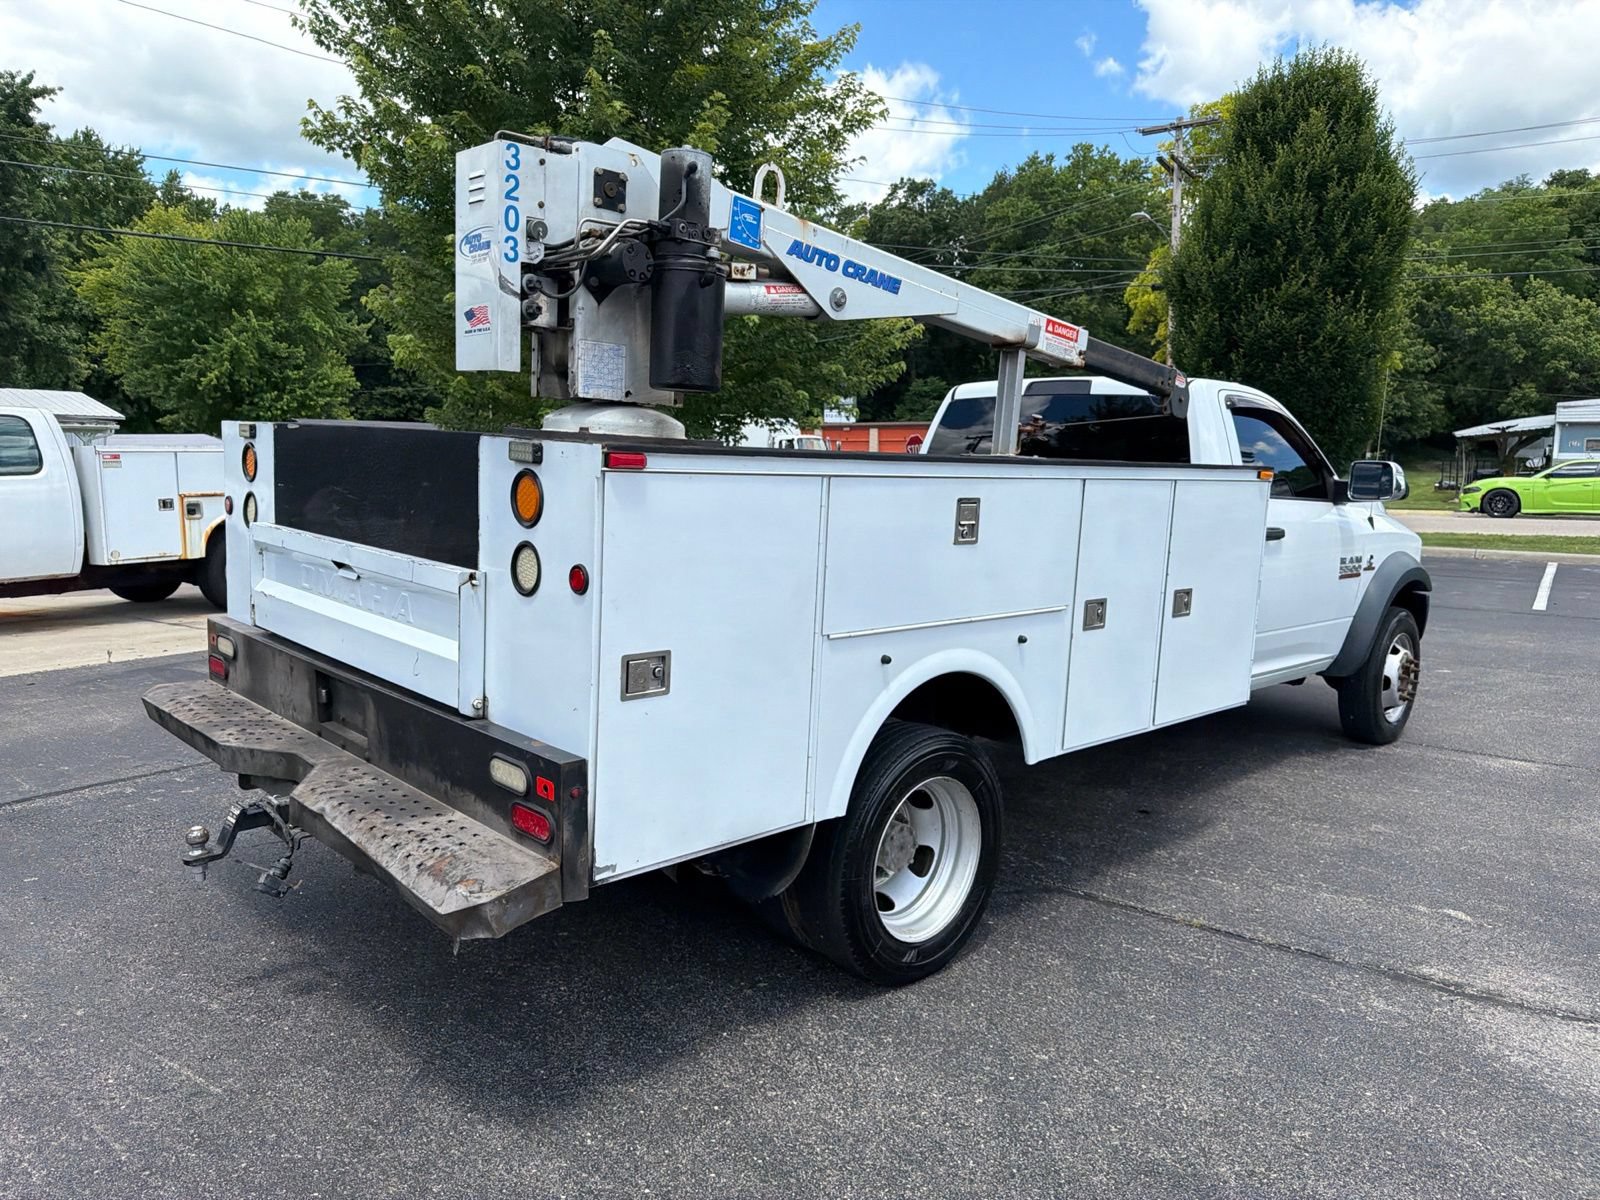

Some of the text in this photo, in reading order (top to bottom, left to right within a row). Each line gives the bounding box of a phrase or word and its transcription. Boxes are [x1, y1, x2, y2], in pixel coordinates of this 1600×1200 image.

[504, 142, 520, 263] 3203
[786, 239, 902, 295] AUTO CRANE
[1340, 556, 1362, 564] RAM
